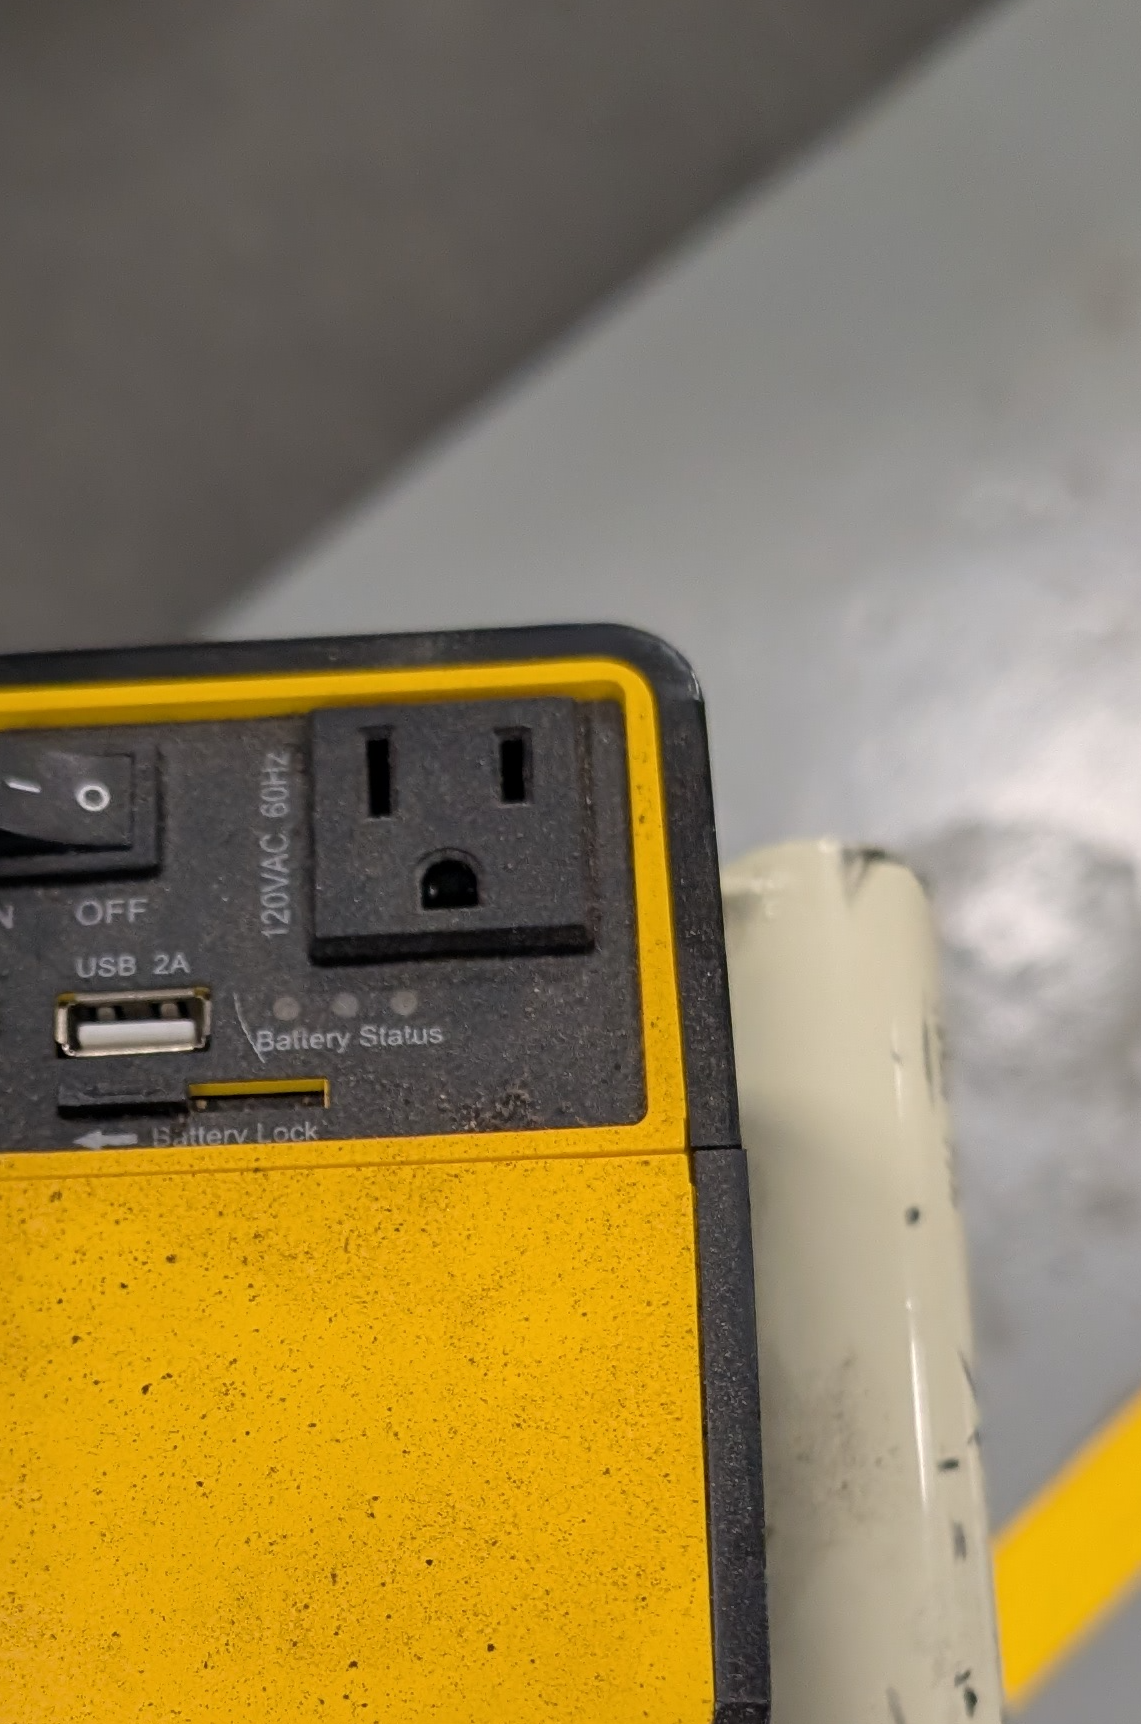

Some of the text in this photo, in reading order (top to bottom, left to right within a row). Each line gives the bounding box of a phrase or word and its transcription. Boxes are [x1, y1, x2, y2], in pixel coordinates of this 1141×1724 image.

[260, 752, 290, 938] 120VAC 60Hz
[75, 898, 149, 926] OFF
[75, 951, 191, 979] USB 2A
[258, 1024, 444, 1053] Battery Status
[258, 1121, 319, 1143] Lock
